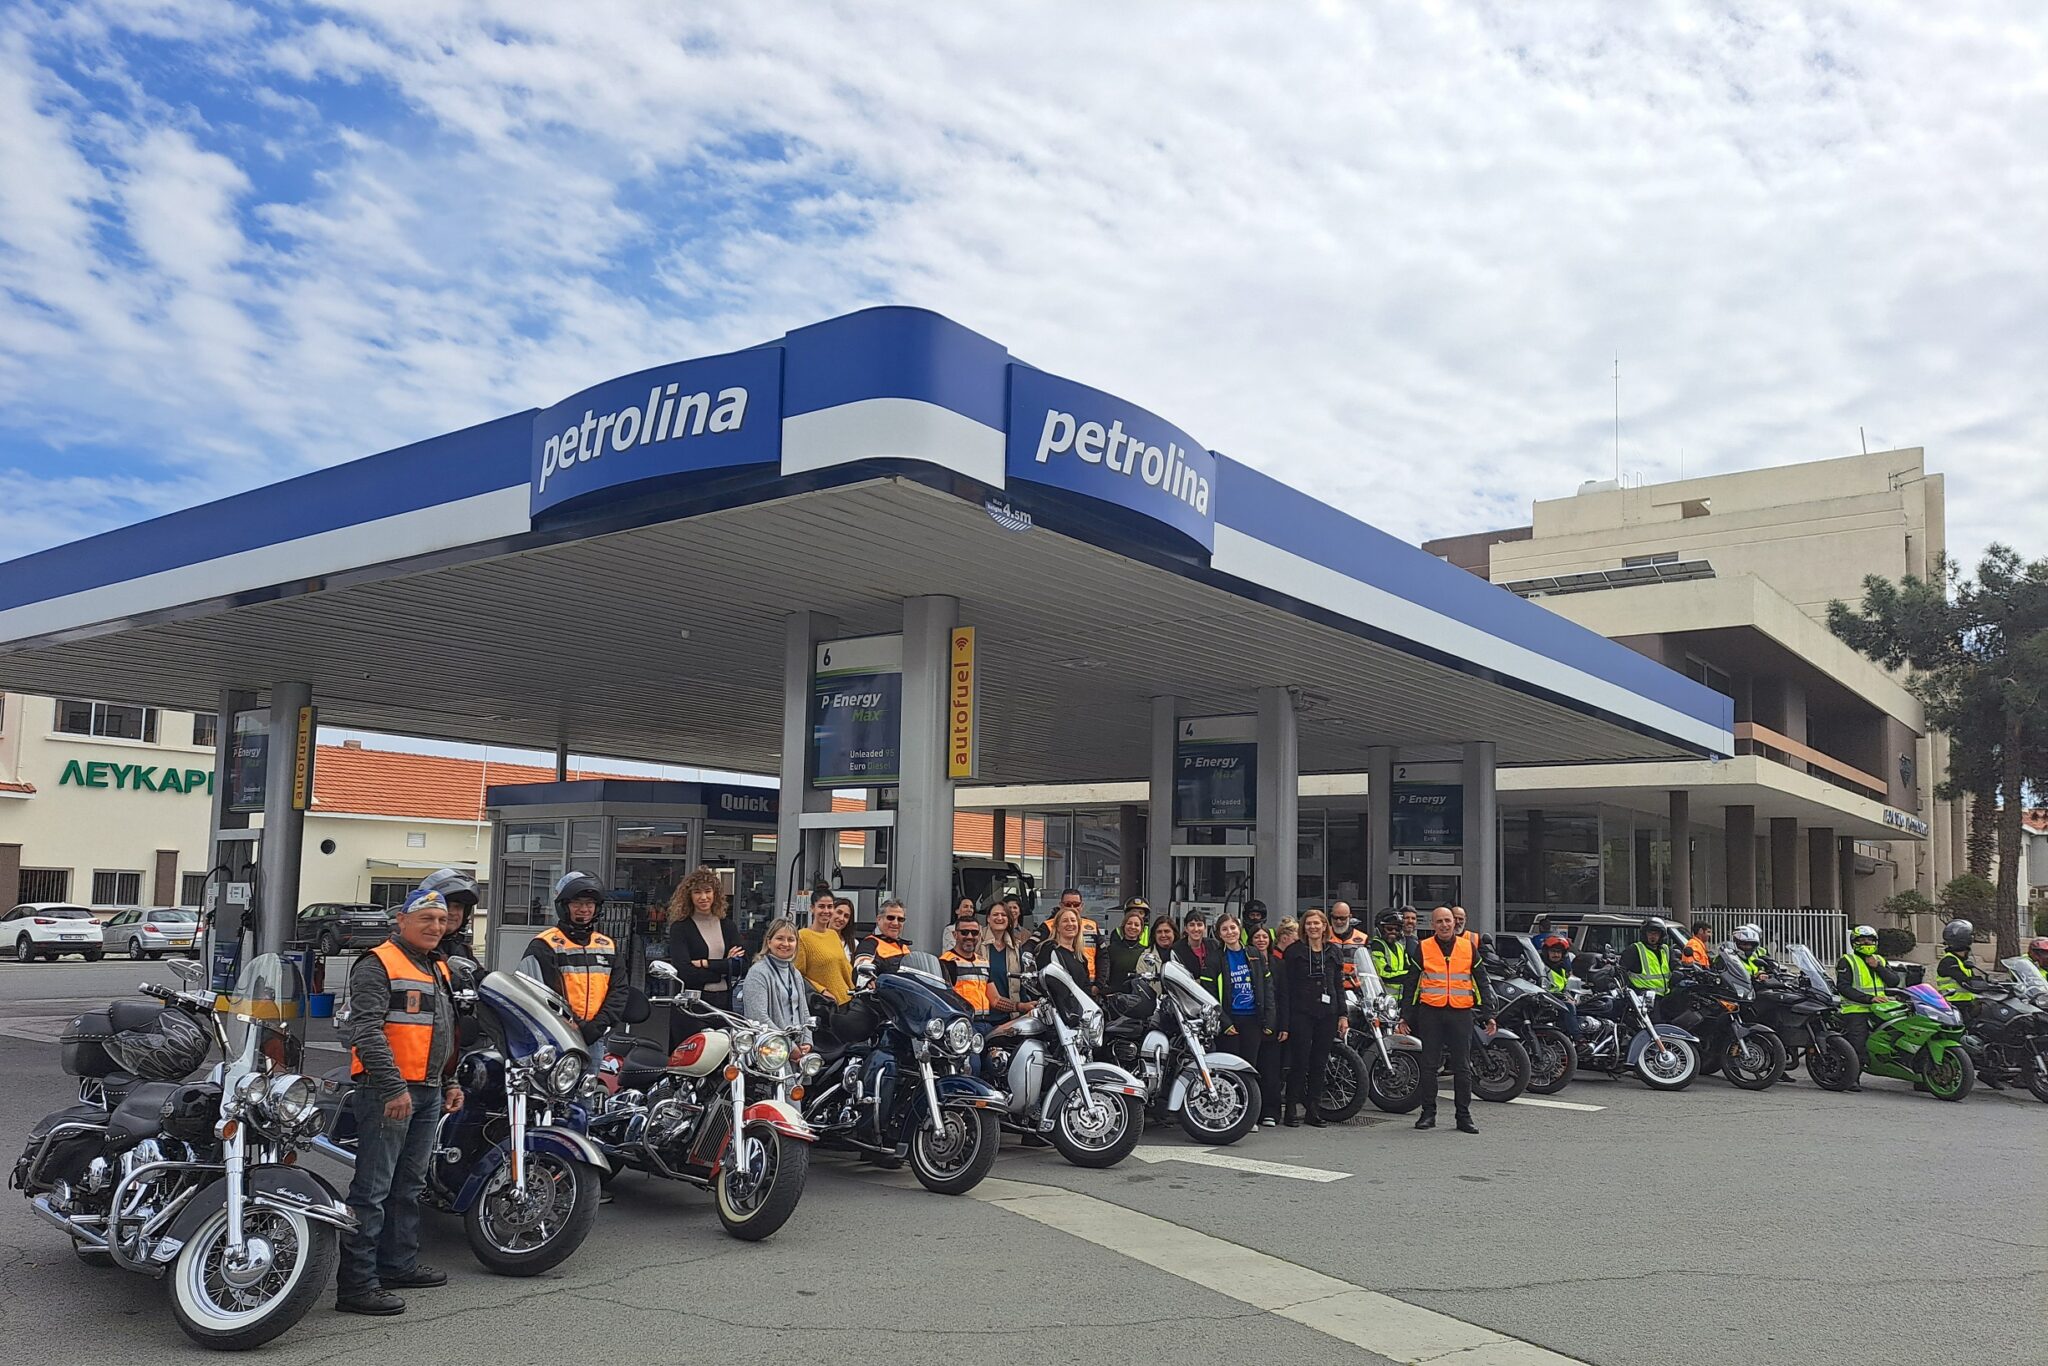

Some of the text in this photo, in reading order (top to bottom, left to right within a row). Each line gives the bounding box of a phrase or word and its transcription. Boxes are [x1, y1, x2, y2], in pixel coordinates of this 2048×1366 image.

[538, 383, 749, 494] petrolina
[1035, 409, 1209, 516] petrolina
[823, 648, 831, 667] 6
[821, 693, 882, 709] P Energy
[852, 709, 881, 721] Max
[953, 662, 969, 765] autofuel
[1185, 723, 1194, 736] 4
[238, 747, 261, 757] Energy
[850, 749, 884, 758] Unleaded
[295, 730, 307, 800] autofuel
[849, 762, 866, 771] Euro
[1184, 757, 1239, 768] P Energy
[1399, 768, 1406, 778] 2
[721, 793, 769, 812] Quick
[1399, 795, 1447, 804] P Energy
